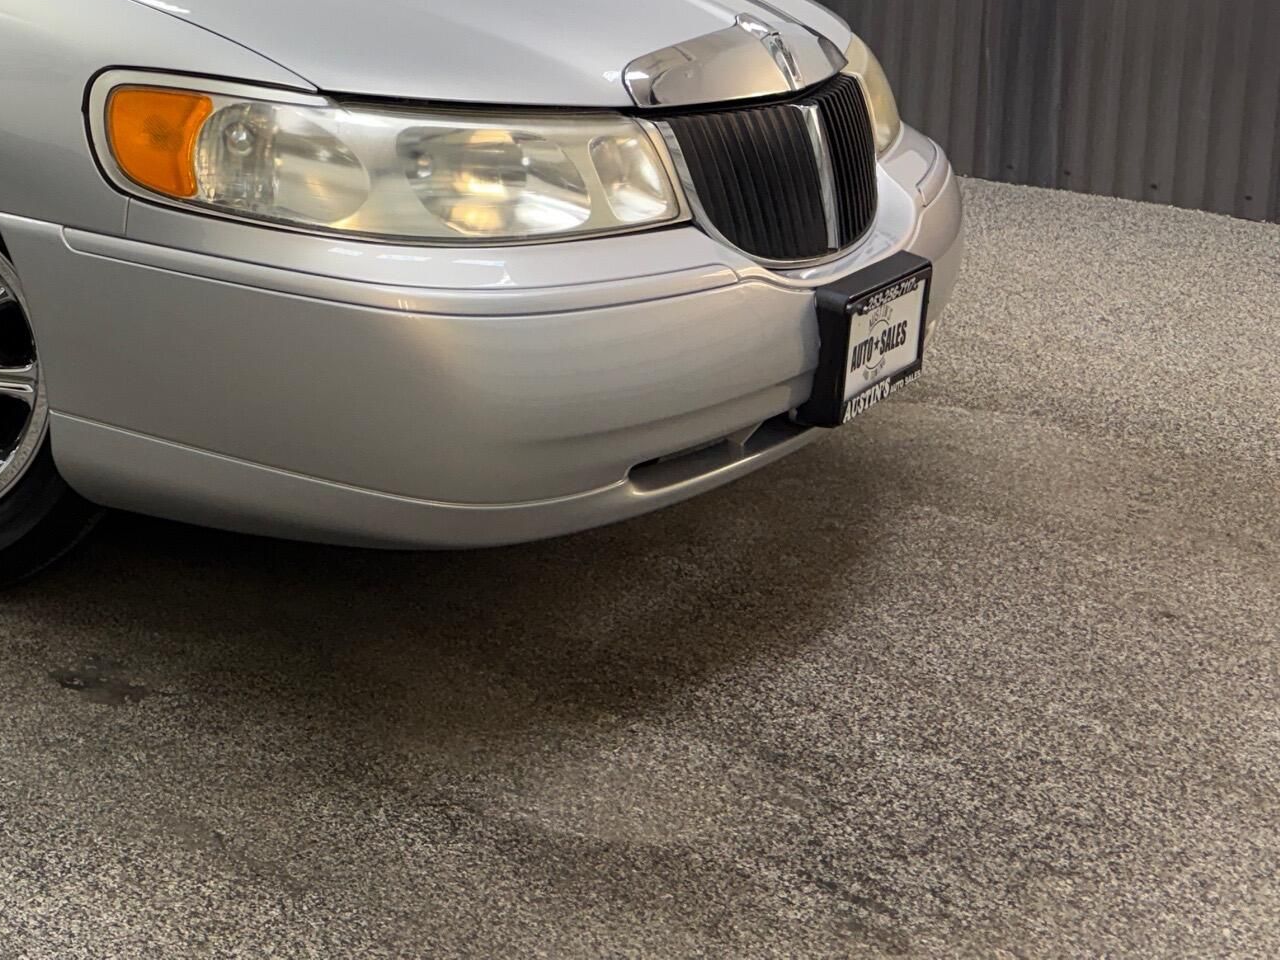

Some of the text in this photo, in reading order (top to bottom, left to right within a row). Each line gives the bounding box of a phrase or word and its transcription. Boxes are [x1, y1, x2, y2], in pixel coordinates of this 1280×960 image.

[850, 336, 874, 373] AUTO
[879, 320, 908, 355] SALES
[842, 377, 891, 424] AUSTIN'S
